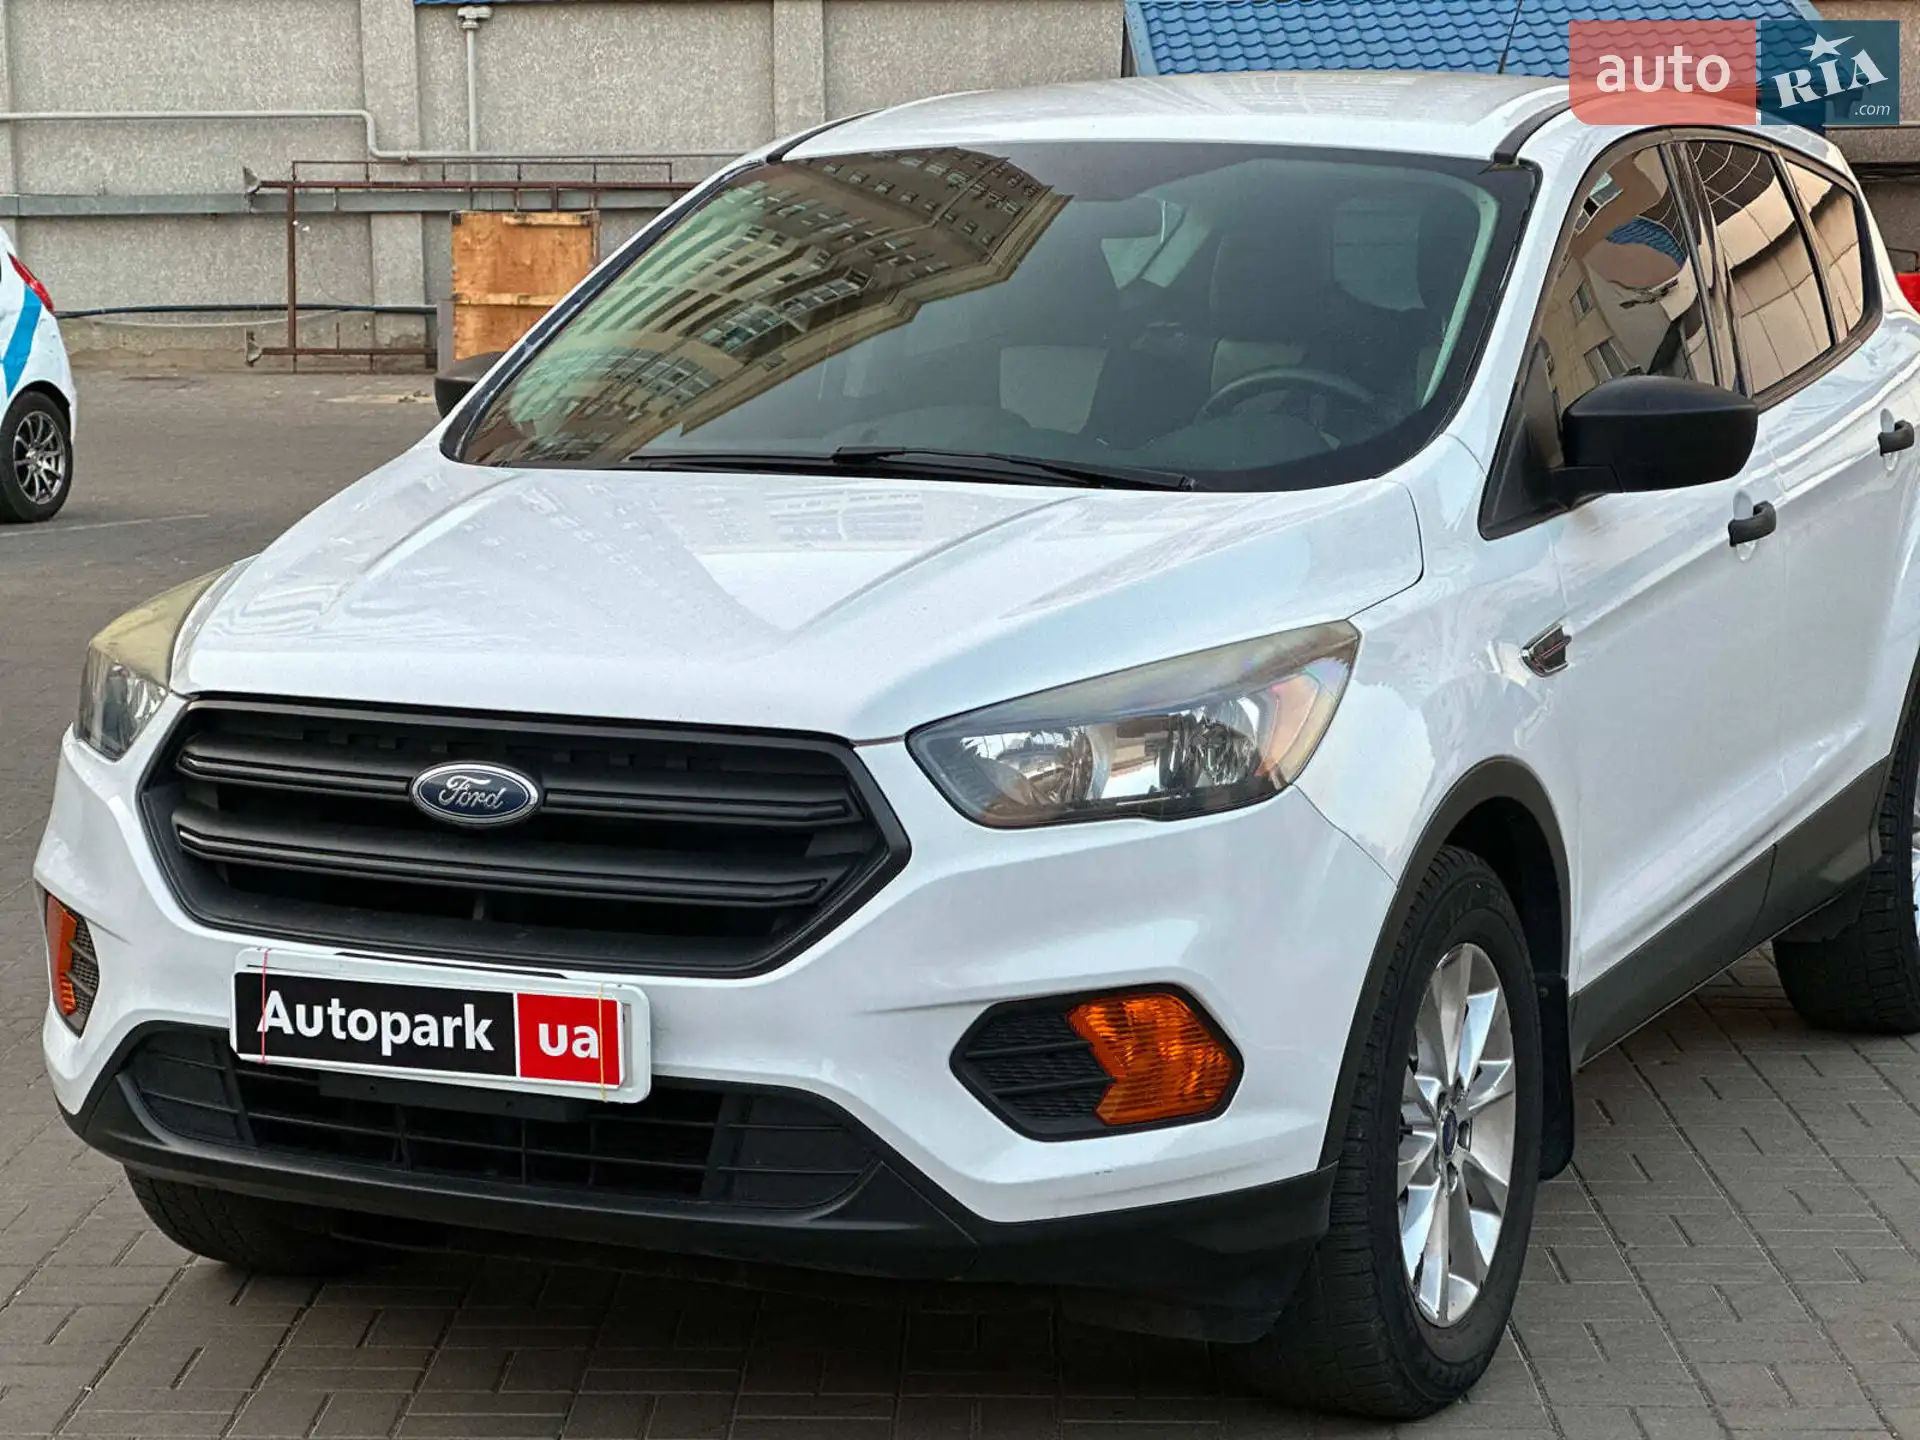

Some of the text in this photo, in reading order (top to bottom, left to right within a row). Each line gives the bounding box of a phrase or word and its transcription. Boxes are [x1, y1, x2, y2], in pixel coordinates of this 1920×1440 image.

[438, 775, 507, 810] Ford
[257, 989, 600, 1060] Autopark ua
